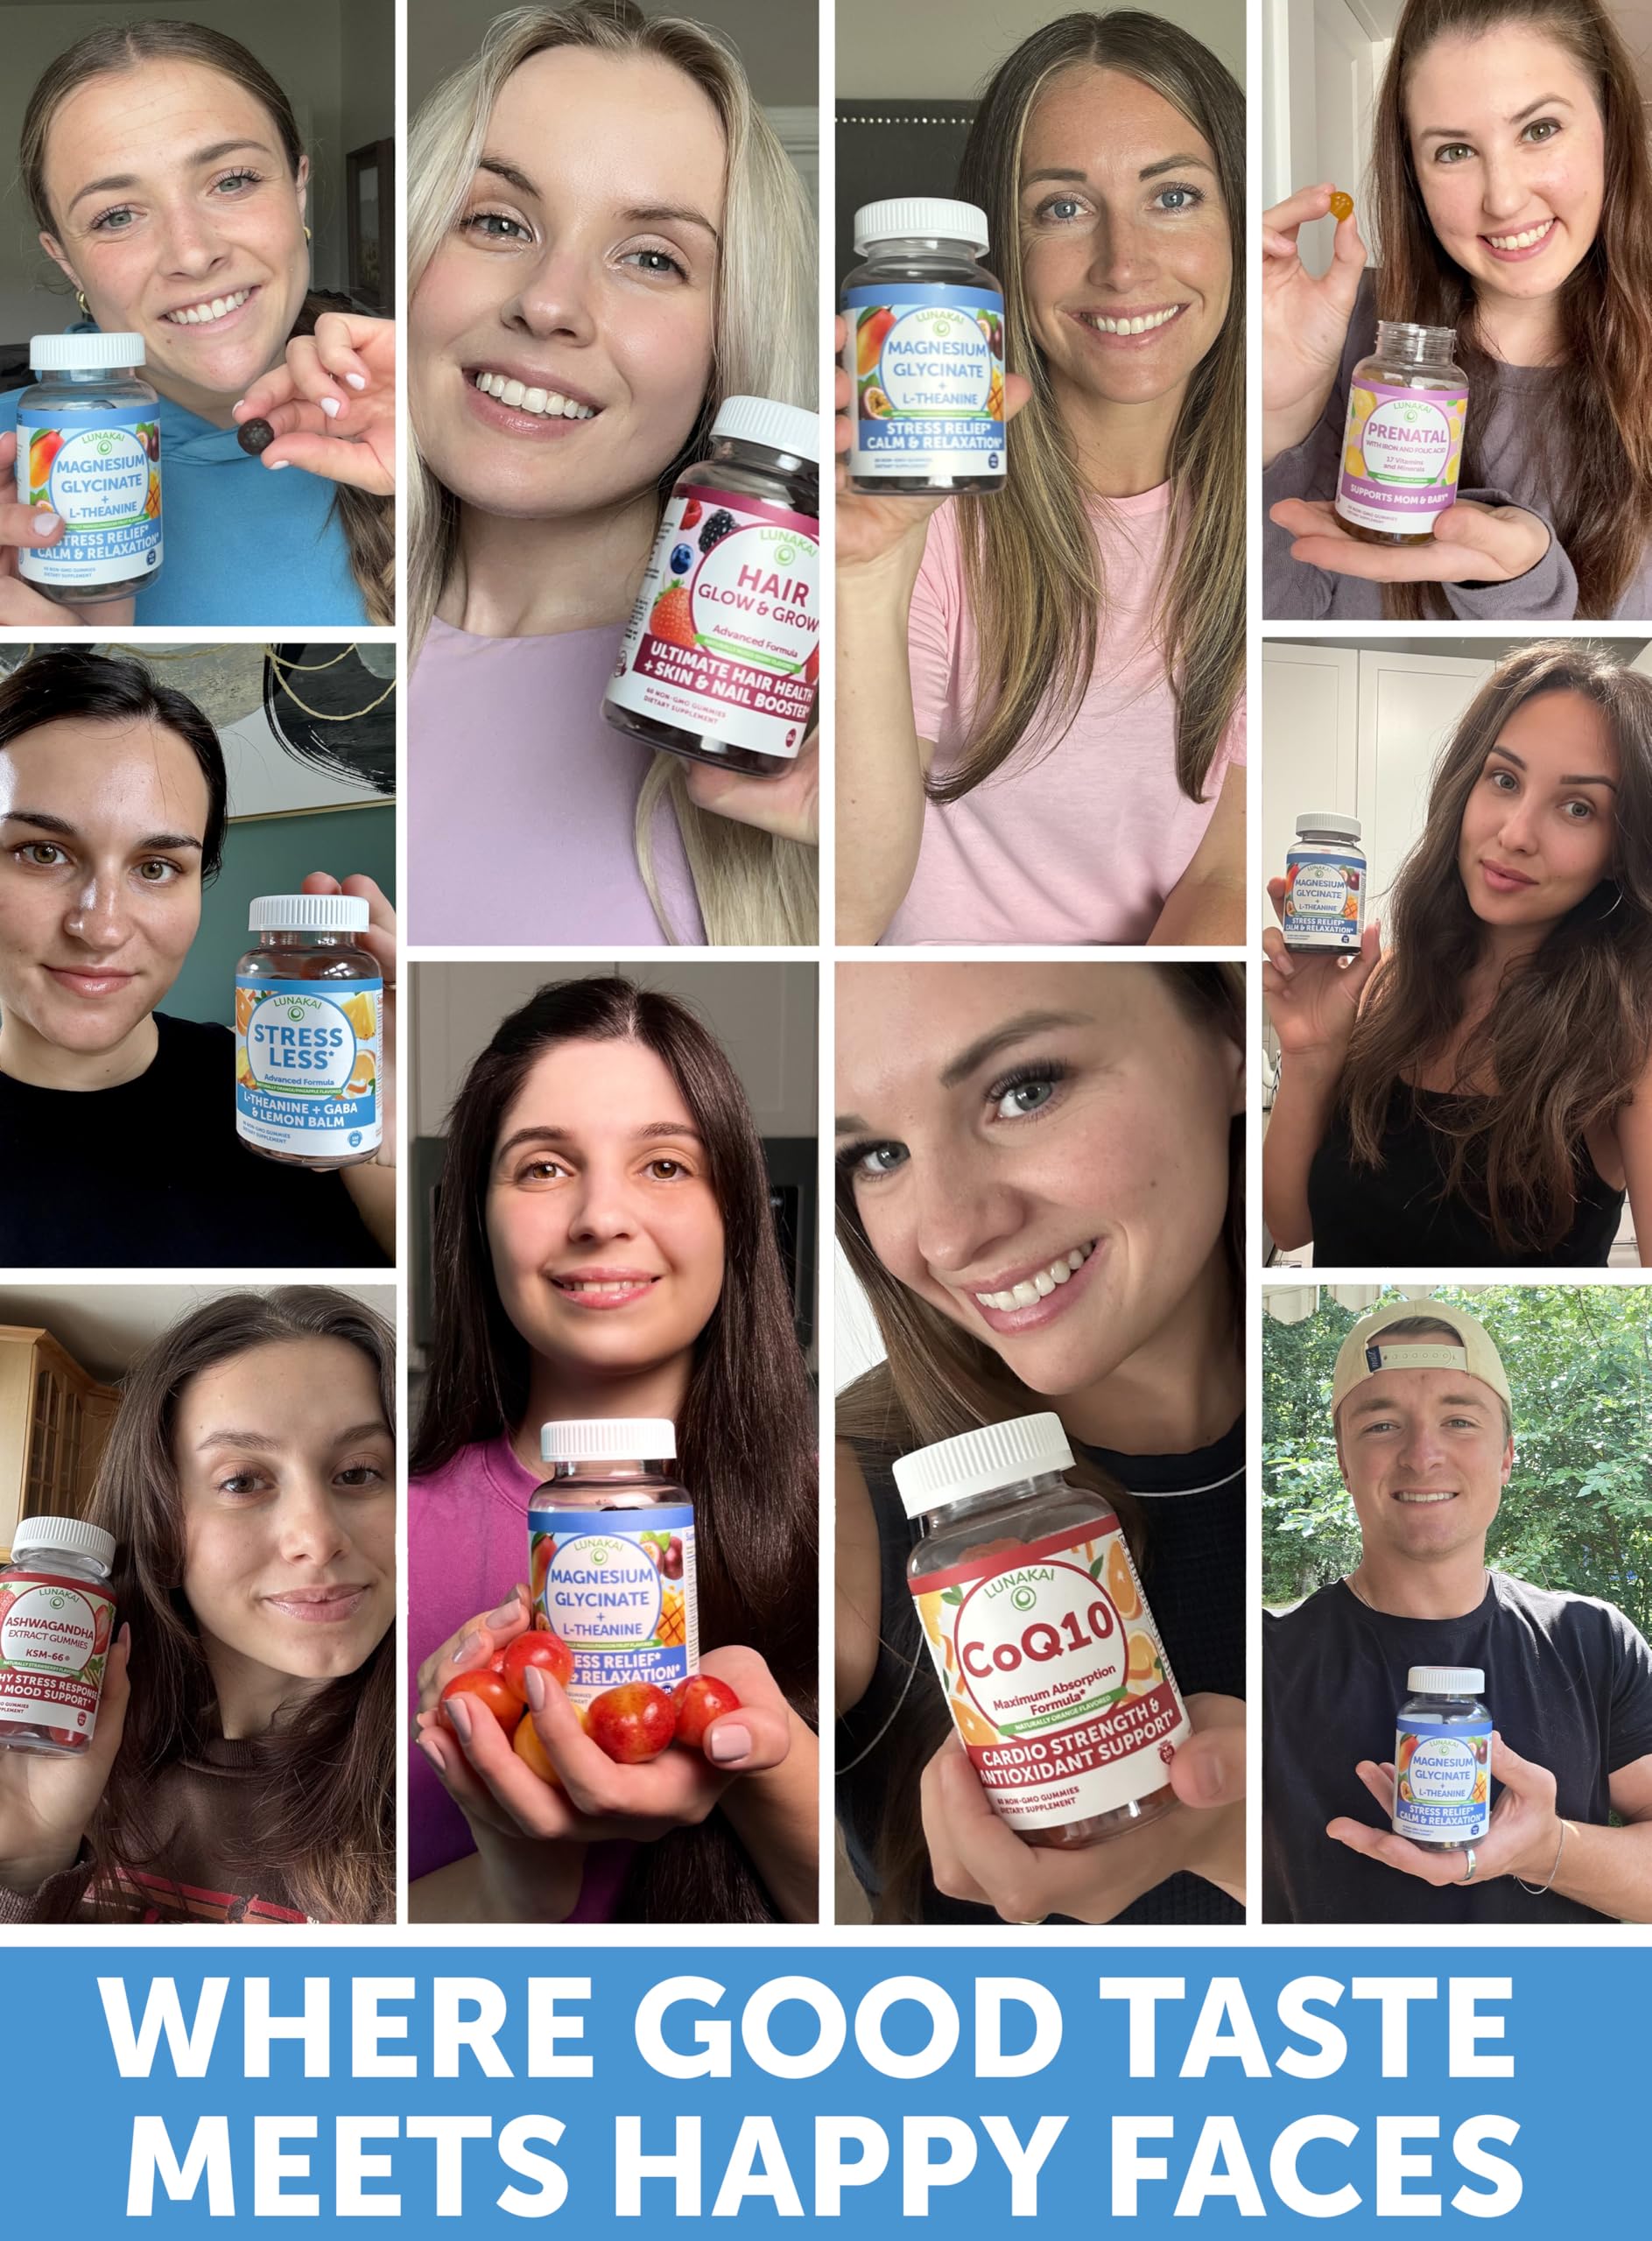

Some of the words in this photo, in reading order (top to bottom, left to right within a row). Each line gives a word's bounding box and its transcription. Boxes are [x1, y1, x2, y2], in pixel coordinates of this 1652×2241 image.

[916, 311, 966, 324] LUNAKAI
[888, 341, 987, 357] MAGNESIUM
[894, 363, 983, 378] GLYCINATE
[903, 393, 978, 404] L-THEANINE
[1394, 402, 1432, 413] LUNAKAI
[887, 422, 942, 434] STRESS
[1368, 422, 1446, 443] PRENATAL
[81, 431, 125, 444] LUNAKAI
[868, 438, 905, 449] CALM
[909, 438, 918, 448] &
[1367, 439, 1382, 448] WITH
[57, 454, 144, 474] MAGNESIUM
[61, 474, 142, 493] GLYCINATE
[1350, 484, 1393, 502] SUPPORTS
[1420, 496, 1426, 505] &
[69, 502, 137, 518] L-THEANINE
[760, 530, 818, 558] LUNAKAI
[38, 547, 71, 559] CALM
[74, 548, 84, 559] &
[737, 565, 809, 607] HAIR
[699, 584, 756, 611] GLOW
[757, 601, 769, 615] &
[772, 606, 819, 631] GROW
[713, 624, 765, 647] Advanced
[766, 642, 798, 658] Formula
[650, 641, 730, 678] ULTIMATE
[732, 667, 773, 692] HAIR
[654, 661, 693, 685] SKIN
[695, 675, 709, 690] &
[711, 679, 751, 705] NAIL
[1296, 880, 1345, 889] MAGNESIUM
[1297, 889, 1342, 899] GLYCINATE
[273, 996, 322, 1009] LUNAKAI
[254, 1023, 343, 1048] STRESS
[264, 1074, 302, 1085] Advanced
[244, 1091, 309, 1113] L-THEANINE
[324, 1104, 357, 1114] GABA
[252, 1107, 258, 1117] &
[261, 1109, 304, 1126] LEMON
[308, 1116, 344, 1128] BALM
[574, 1539, 623, 1551] LUNAKAI
[551, 1569, 653, 1584] MAGNESIUM
[983, 1569, 1055, 1598] LUNAKAI
[39, 1589, 80, 1603] LUNAKAI
[555, 1591, 650, 1606] GLYCINATE
[5, 1617, 94, 1640] ASHWAGANDHA
[564, 1623, 643, 1635] L-THEANINE
[9, 1631, 48, 1642] EXTRACT
[49, 1634, 88, 1650] GUMMIES
[962, 1600, 1114, 1678] CoQ10
[576, 1654, 601, 1668] ESS
[4, 1684, 41, 1696] MOOD
[15, 1675, 56, 1688] STRESS
[59, 1682, 97, 1700] RESPONSE
[993, 1689, 1051, 1711] Maximum
[1052, 1665, 1116, 1697] Absorption
[1015, 1717, 1051, 1731] NATURALLY
[1051, 1708, 1079, 1722] ORANGE
[1078, 1695, 1111, 1712] FLAVORED
[981, 1744, 1047, 1767] CARDIO
[1050, 1703, 1149, 1754] STRENGTH
[1150, 1697, 1160, 1713] &
[979, 1750, 1094, 1786] ANTIOXIDANT
[1413, 1756, 1473, 1767] MAGNESIUM
[1415, 1770, 1471, 1781] GLYCINATE
[1004, 1795, 1039, 1804] NON-GMO
[1041, 1786, 1079, 1801] GUMMIES
[1419, 1788, 1466, 1797] L-THEANINE
[1025, 1797, 1076, 1813] SUPPLEMENT
[1409, 1805, 1441, 1816] STRESS
[1400, 1811, 1419, 1823] CALM
